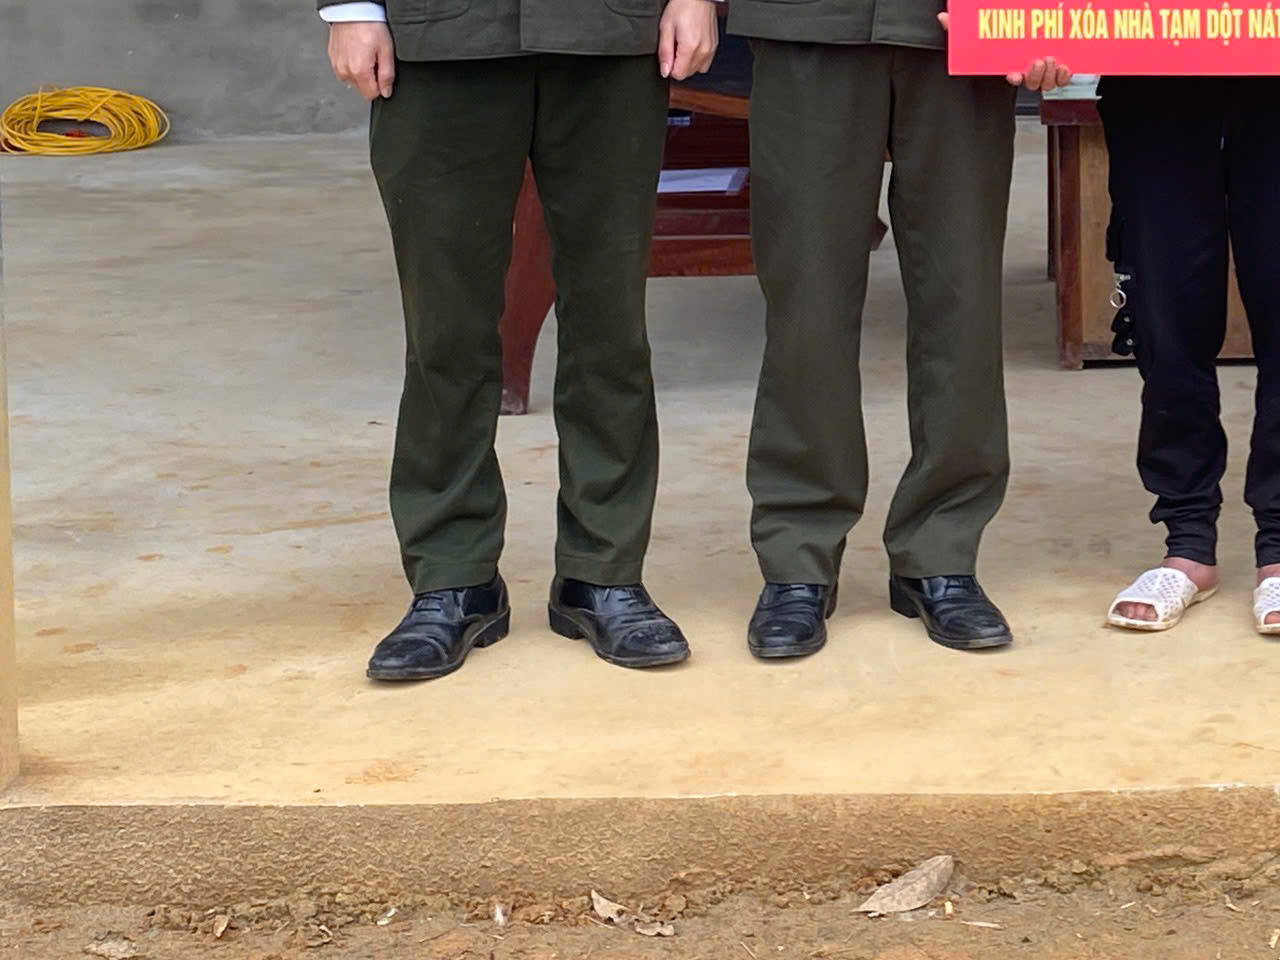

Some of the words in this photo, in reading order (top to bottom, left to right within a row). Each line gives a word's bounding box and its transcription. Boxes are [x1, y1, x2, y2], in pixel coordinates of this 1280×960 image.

[978, 8, 1025, 39] KINH
[1030, 2, 1064, 39] PHÍ
[1068, 2, 1109, 39] XÓA
[1113, 2, 1155, 39] NHÀ
[1159, 8, 1201, 45] TẠM
[1206, 2, 1244, 46] DỘT
